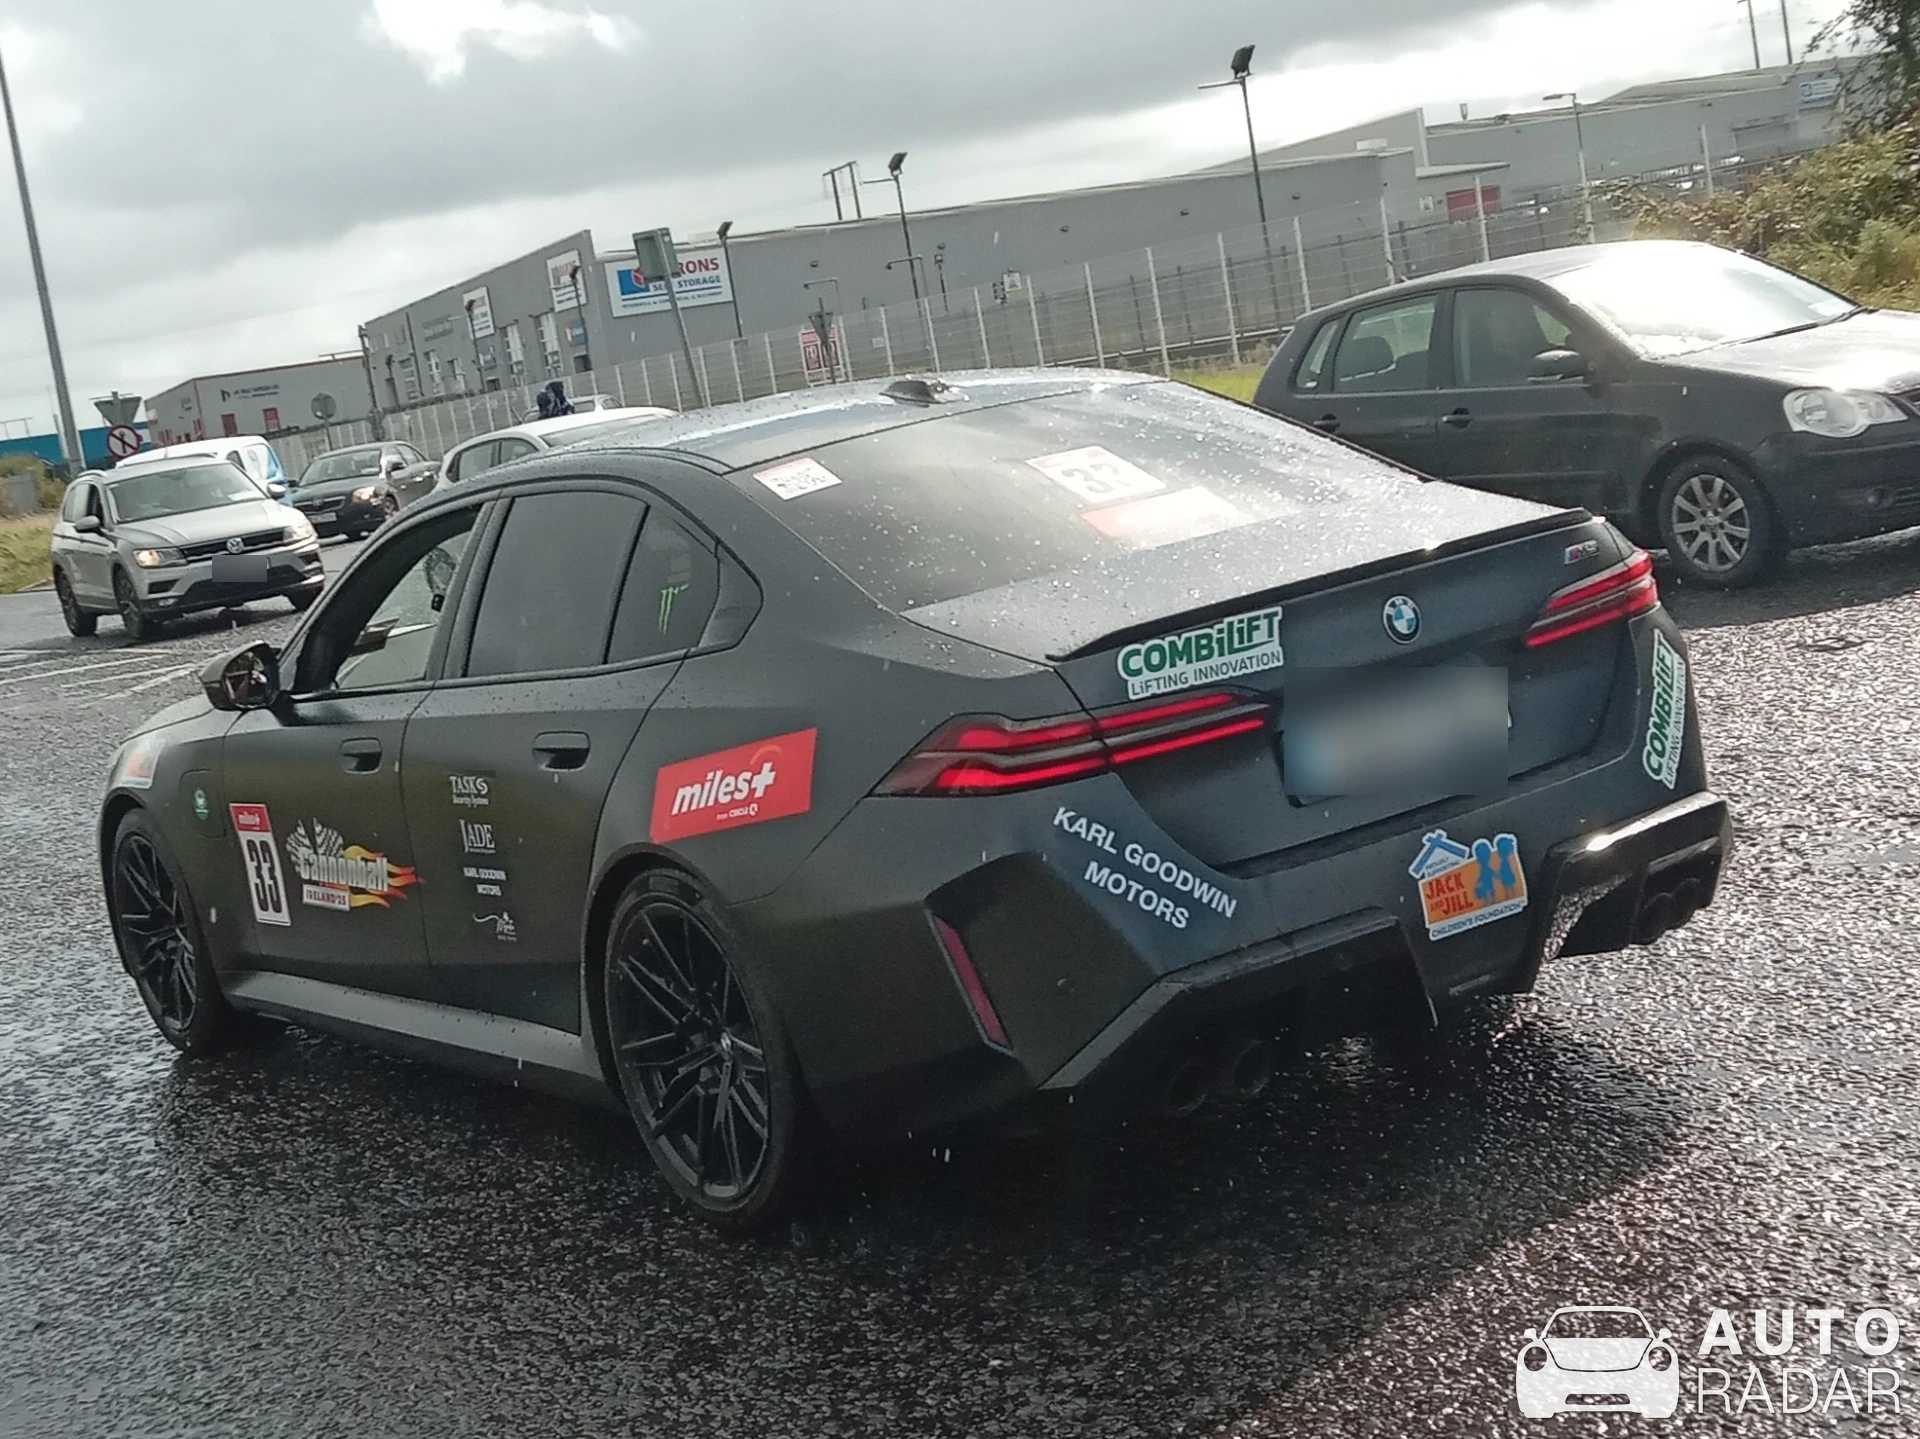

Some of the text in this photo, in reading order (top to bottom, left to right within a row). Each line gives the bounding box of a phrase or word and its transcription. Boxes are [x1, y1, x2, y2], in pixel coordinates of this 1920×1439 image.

[677, 275, 721, 288] STORAGE
[1194, 650, 1281, 682] INNOVATION
[671, 761, 776, 816] miles+
[246, 838, 283, 914] 33
[1053, 806, 1238, 918] KARL GOODWIN
[1084, 861, 1190, 929] MOTORS
[1426, 872, 1465, 900] JACK
[1442, 891, 1474, 915] JILL
